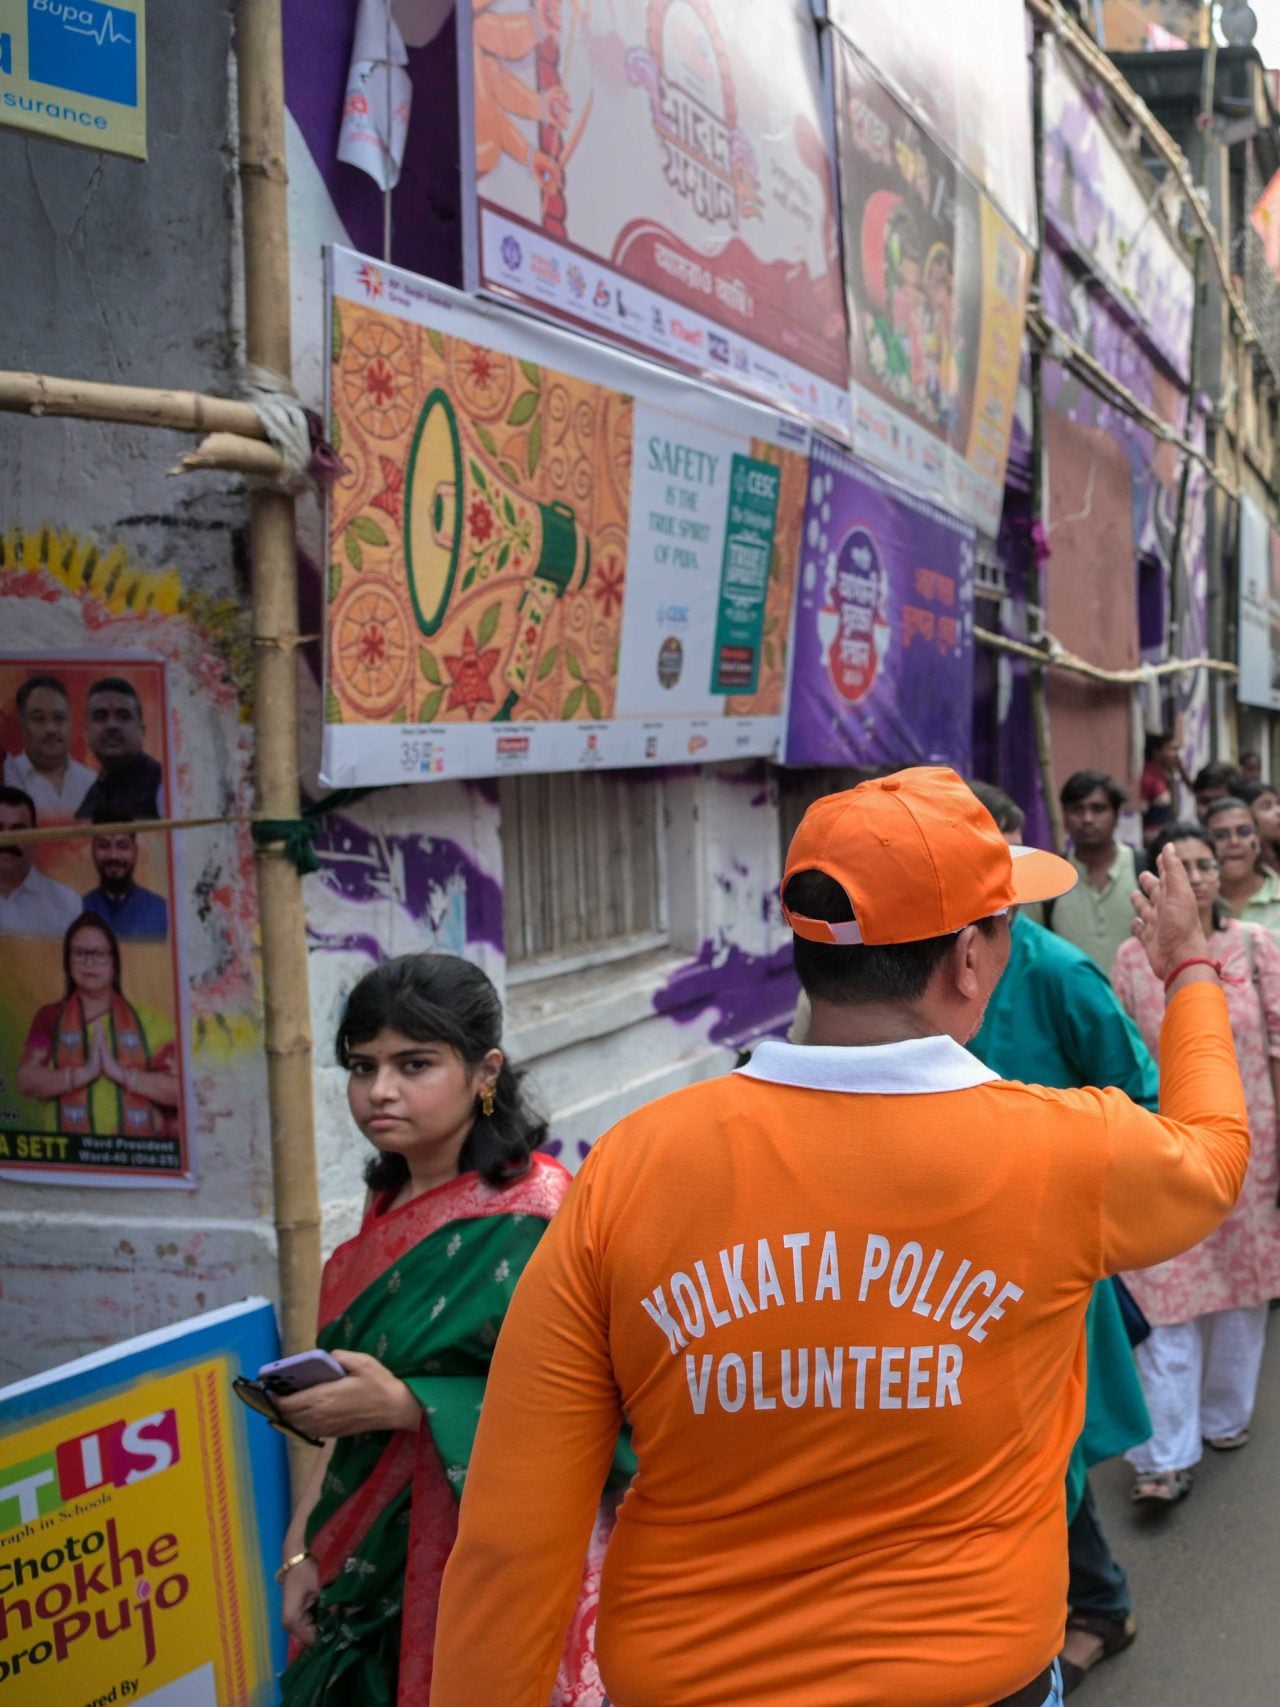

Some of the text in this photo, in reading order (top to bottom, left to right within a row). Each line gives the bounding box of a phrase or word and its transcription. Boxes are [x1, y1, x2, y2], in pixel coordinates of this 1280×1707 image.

[33, 0, 93, 24] Bupa
[647, 435, 719, 487] SAFETY
[665, 486, 698, 512] IS THE
[747, 471, 777, 500] CESC
[649, 511, 711, 544] TRUE SPIRIT
[654, 543, 670, 565] OF
[16, 1134, 68, 1160] SETT
[81, 1136, 175, 1153] Ward President
[640, 1231, 1025, 1356] KOLKATA POLICE
[685, 1343, 964, 1415] VOLUNTEER
[39, 1517, 55, 1531] in
[58, 1492, 113, 1521] Schools
[53, 1573, 189, 1668] Pujo
[120, 1677, 140, 1698] By
